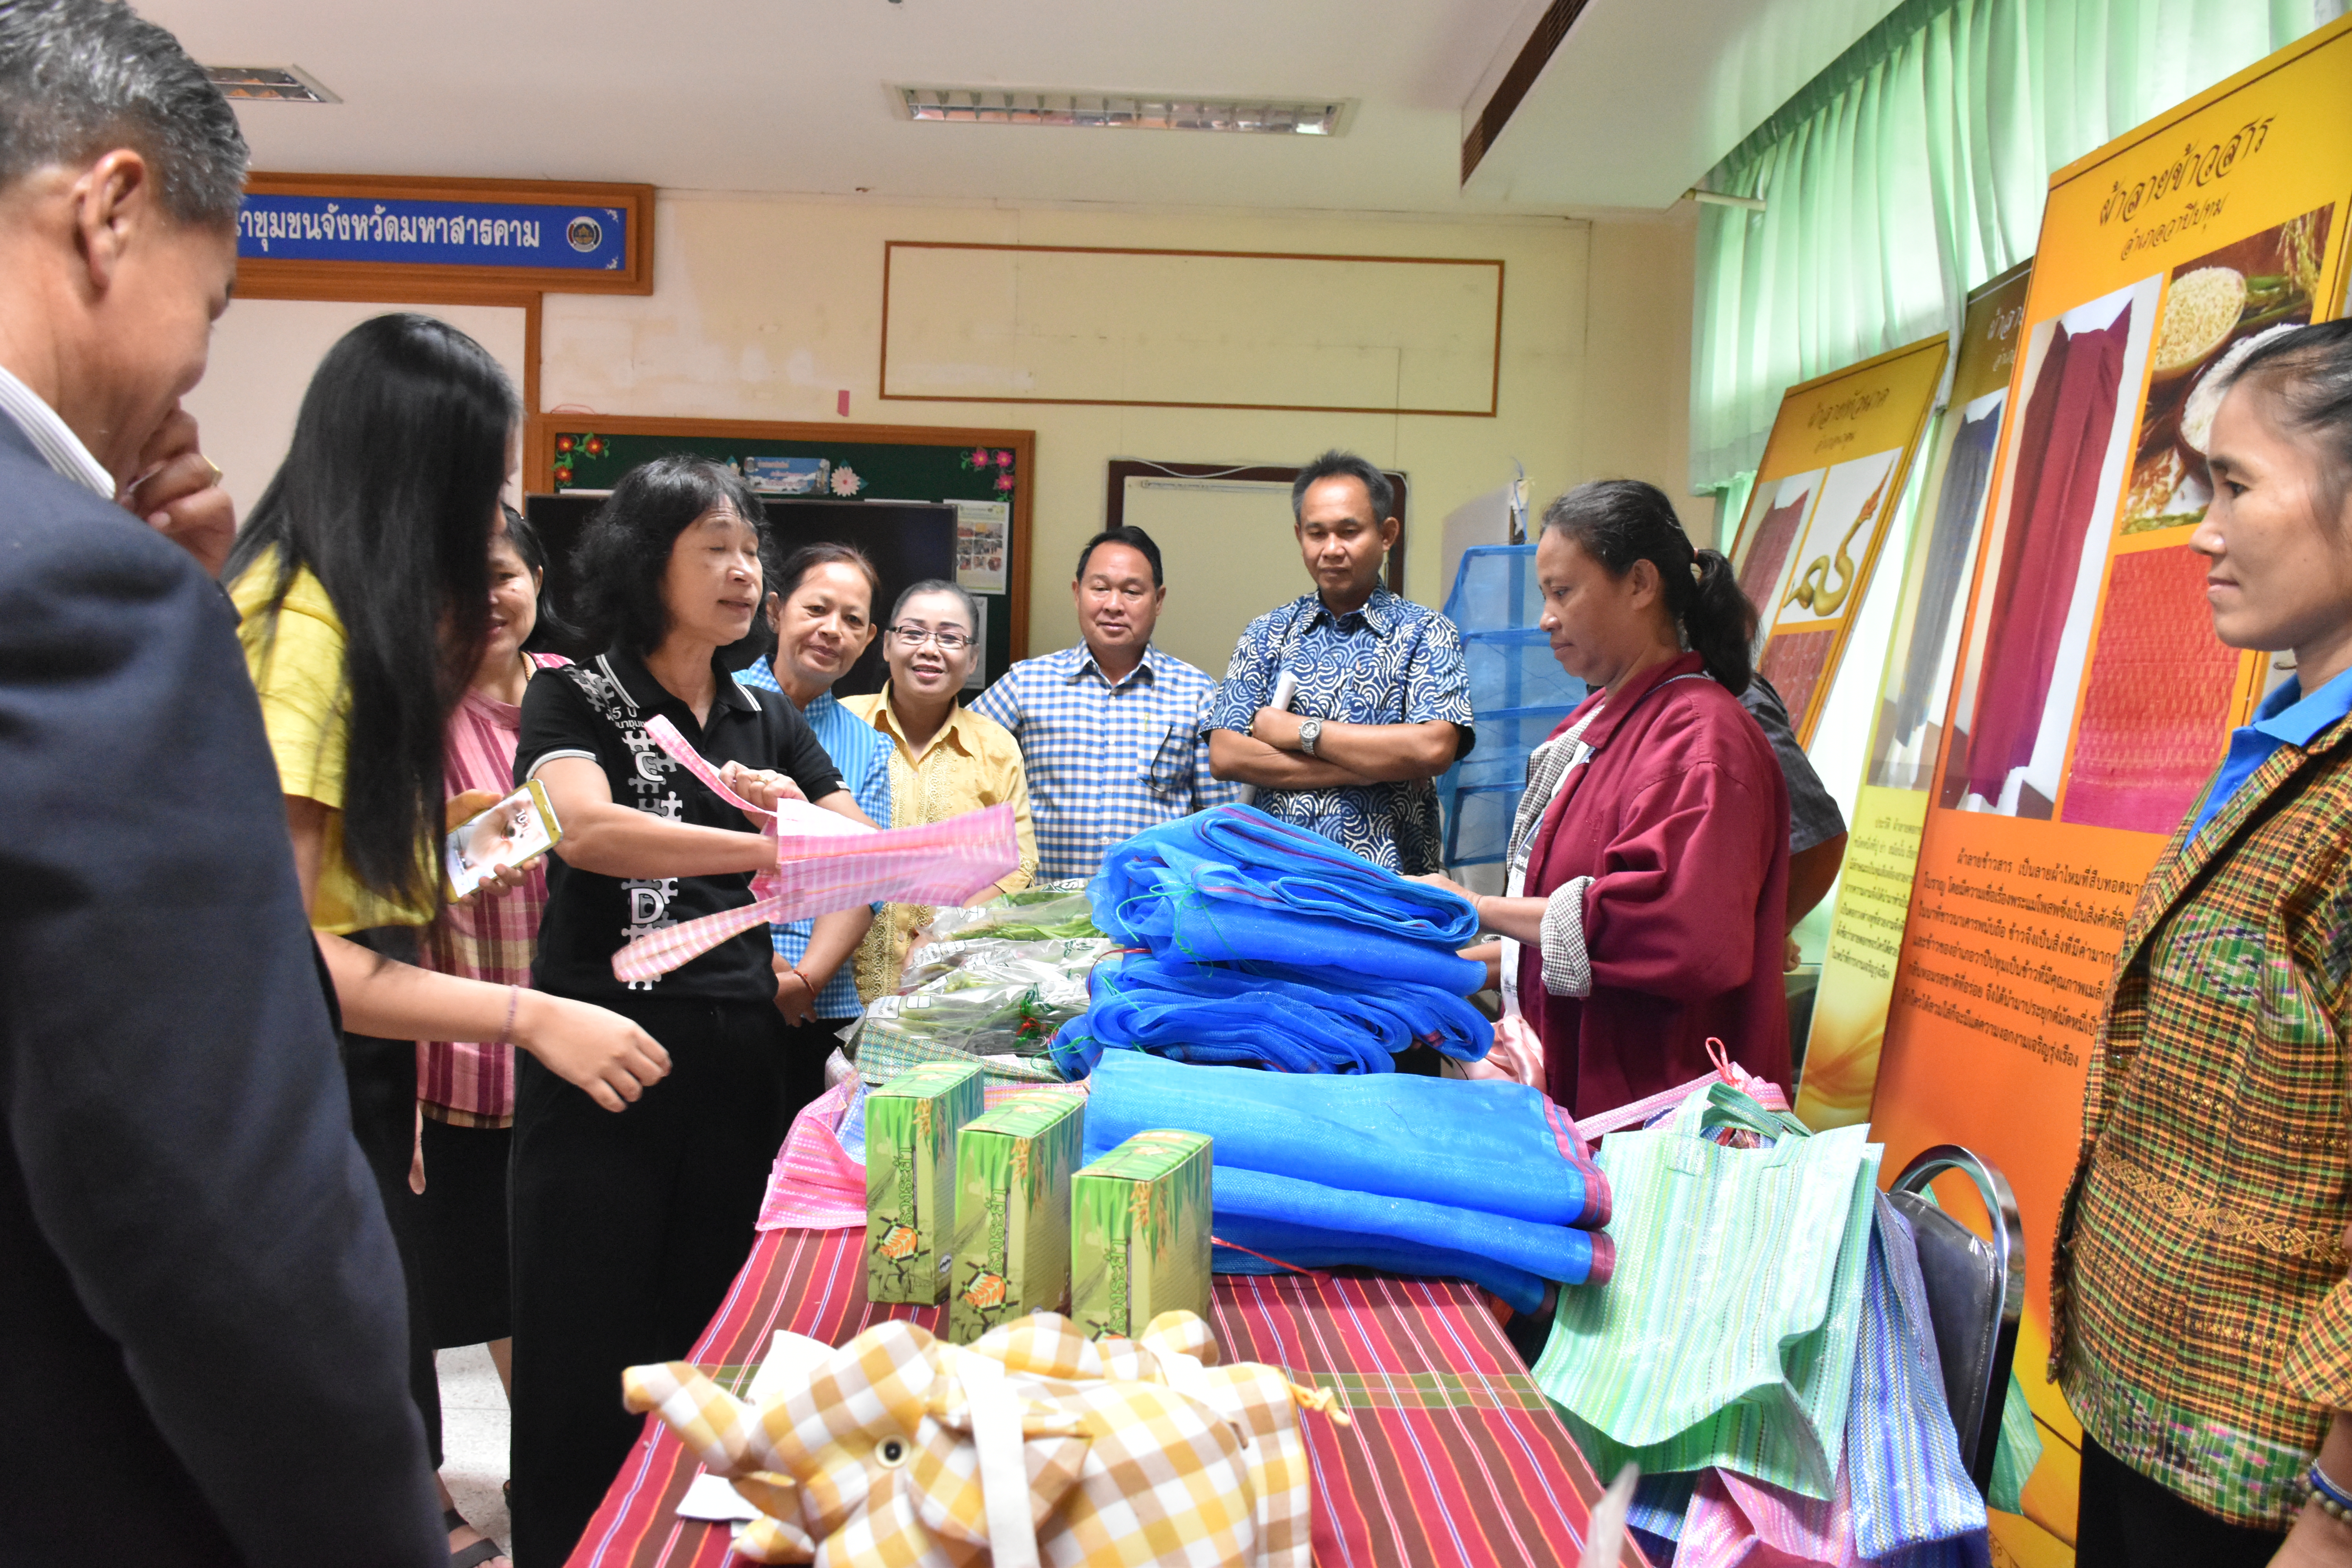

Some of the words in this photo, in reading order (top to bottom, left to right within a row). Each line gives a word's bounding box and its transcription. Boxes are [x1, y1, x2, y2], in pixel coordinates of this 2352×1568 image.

[236, 203, 540, 252] าชุมชนจังหวัดมหาสารคาม
[630, 887, 665, 924] D
